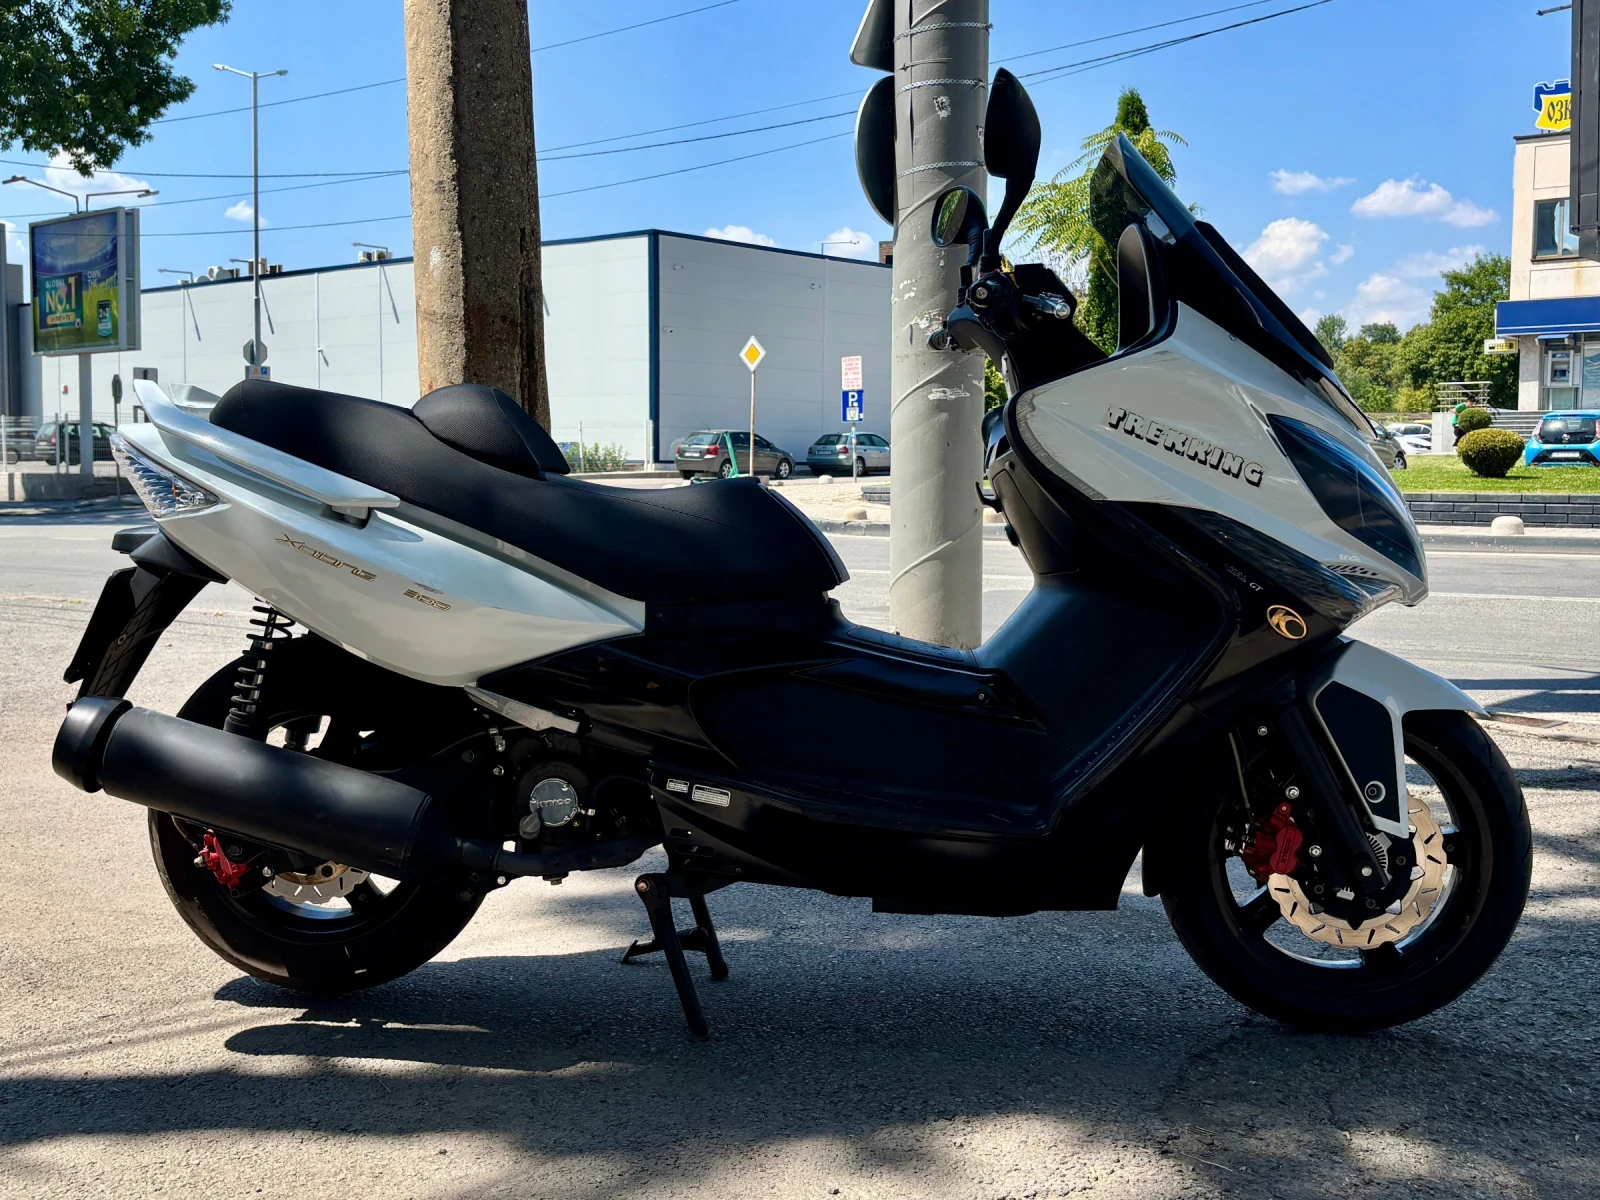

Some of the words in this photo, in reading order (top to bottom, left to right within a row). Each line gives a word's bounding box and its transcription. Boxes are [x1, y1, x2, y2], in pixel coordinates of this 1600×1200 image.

[849, 392, 858, 407] P
[1107, 406, 1265, 488] TREKKING
[1249, 582, 1264, 592] GT
